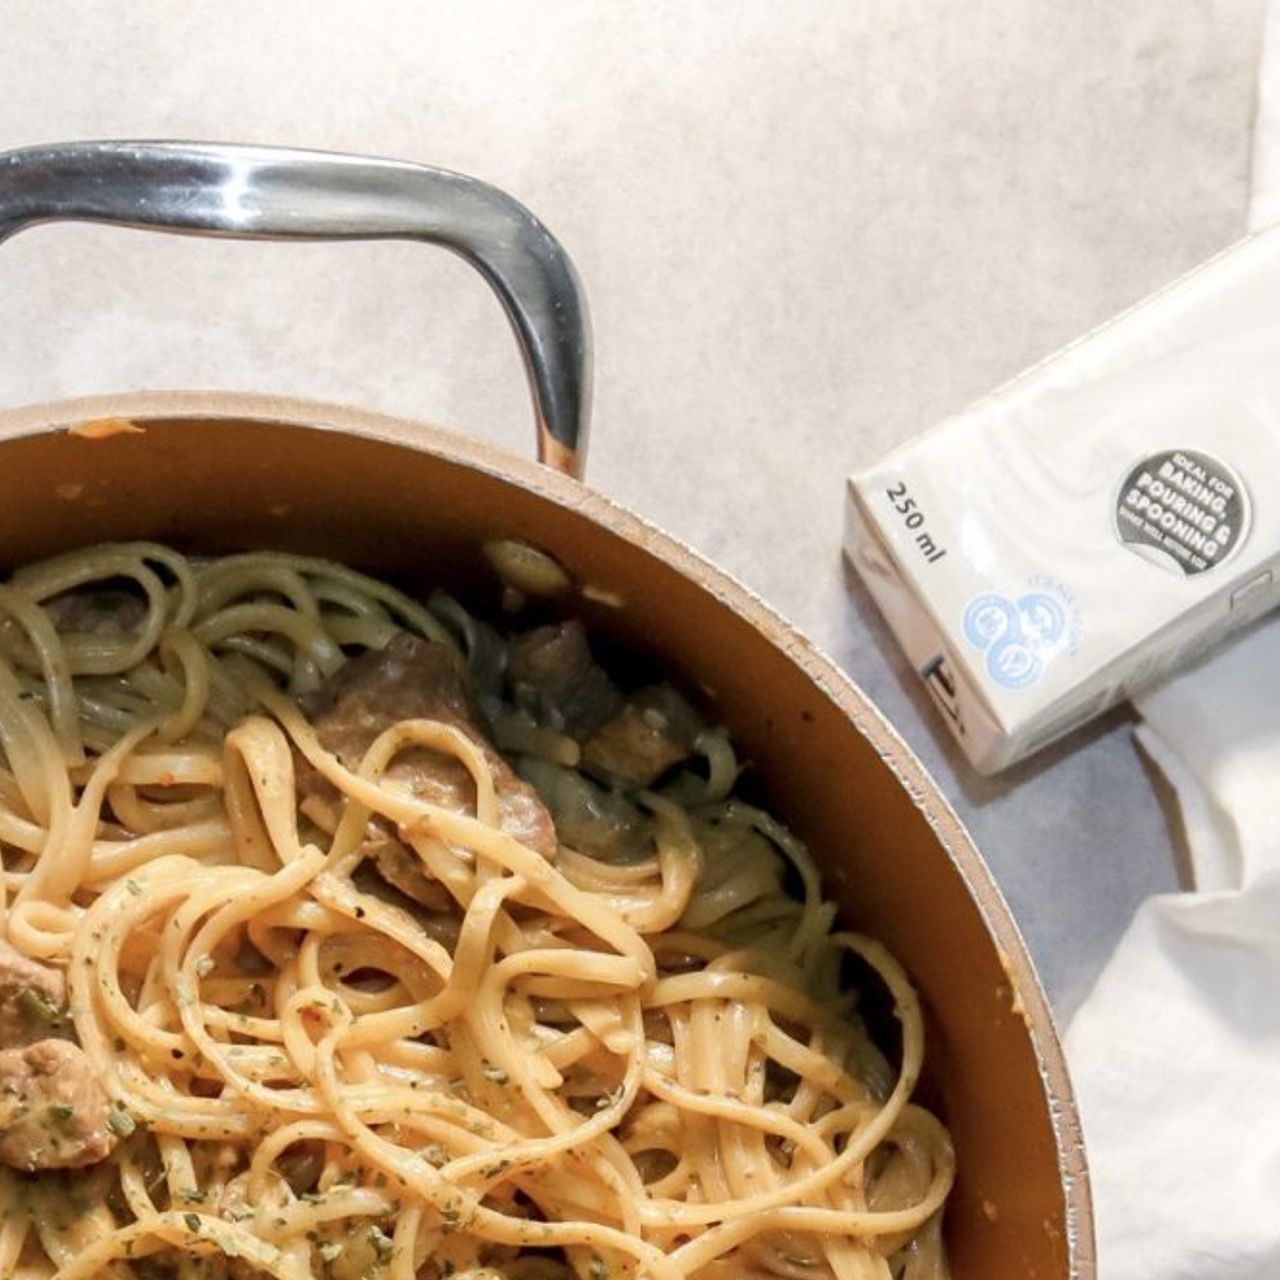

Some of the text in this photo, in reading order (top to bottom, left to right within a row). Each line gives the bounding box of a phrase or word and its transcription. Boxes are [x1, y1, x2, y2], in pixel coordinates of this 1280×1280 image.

[1136, 472, 1231, 546] POURING &
[1158, 461, 1227, 520] BAKING,
[1172, 452, 1234, 500] IDEAL FOR
[886, 481, 947, 563] 250 ml
[1125, 488, 1218, 557] SPOONING
